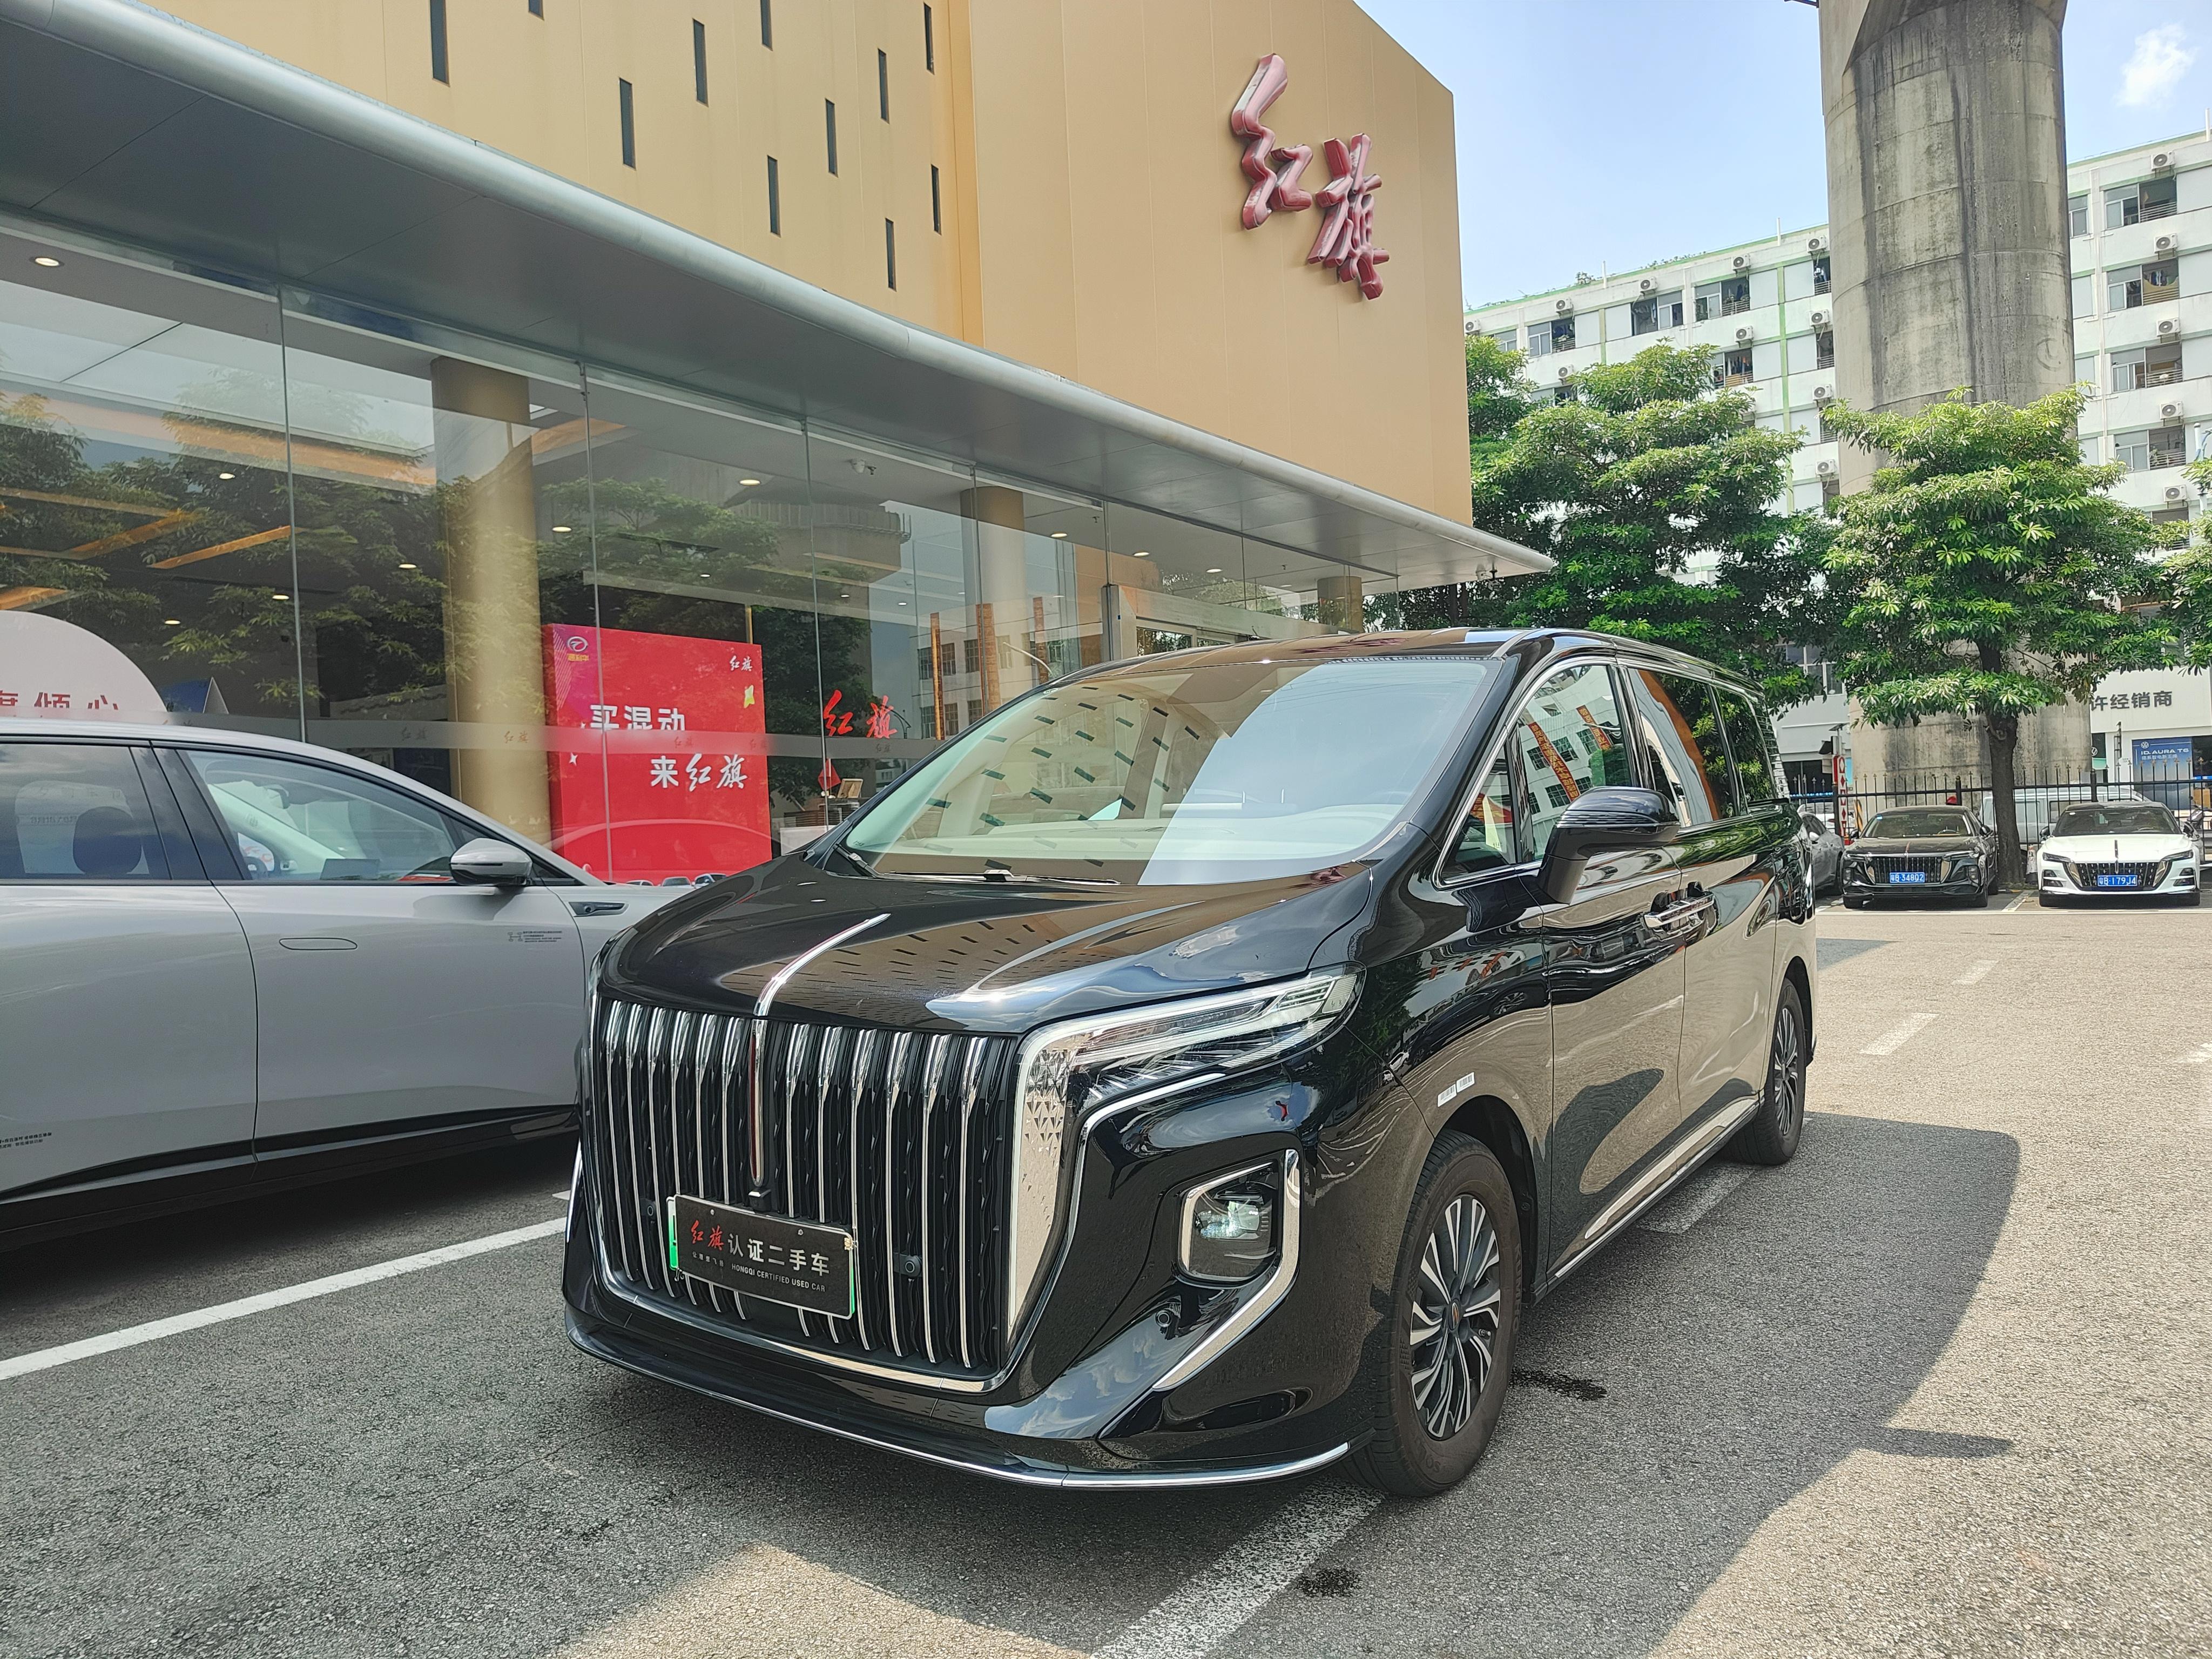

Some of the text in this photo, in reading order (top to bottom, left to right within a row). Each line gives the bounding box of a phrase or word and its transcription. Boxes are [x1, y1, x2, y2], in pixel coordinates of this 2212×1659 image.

[1231, 52, 1391, 301] 红旗
[729, 655, 753, 672] 红旗
[590, 704, 685, 731] 买混动
[823, 689, 898, 739] 红旗
[731, 1263, 756, 1276] HONGQI
[757, 1270, 790, 1284] CERTIFIED
[791, 1279, 810, 1289] USED
[811, 1283, 826, 1292] CAR
